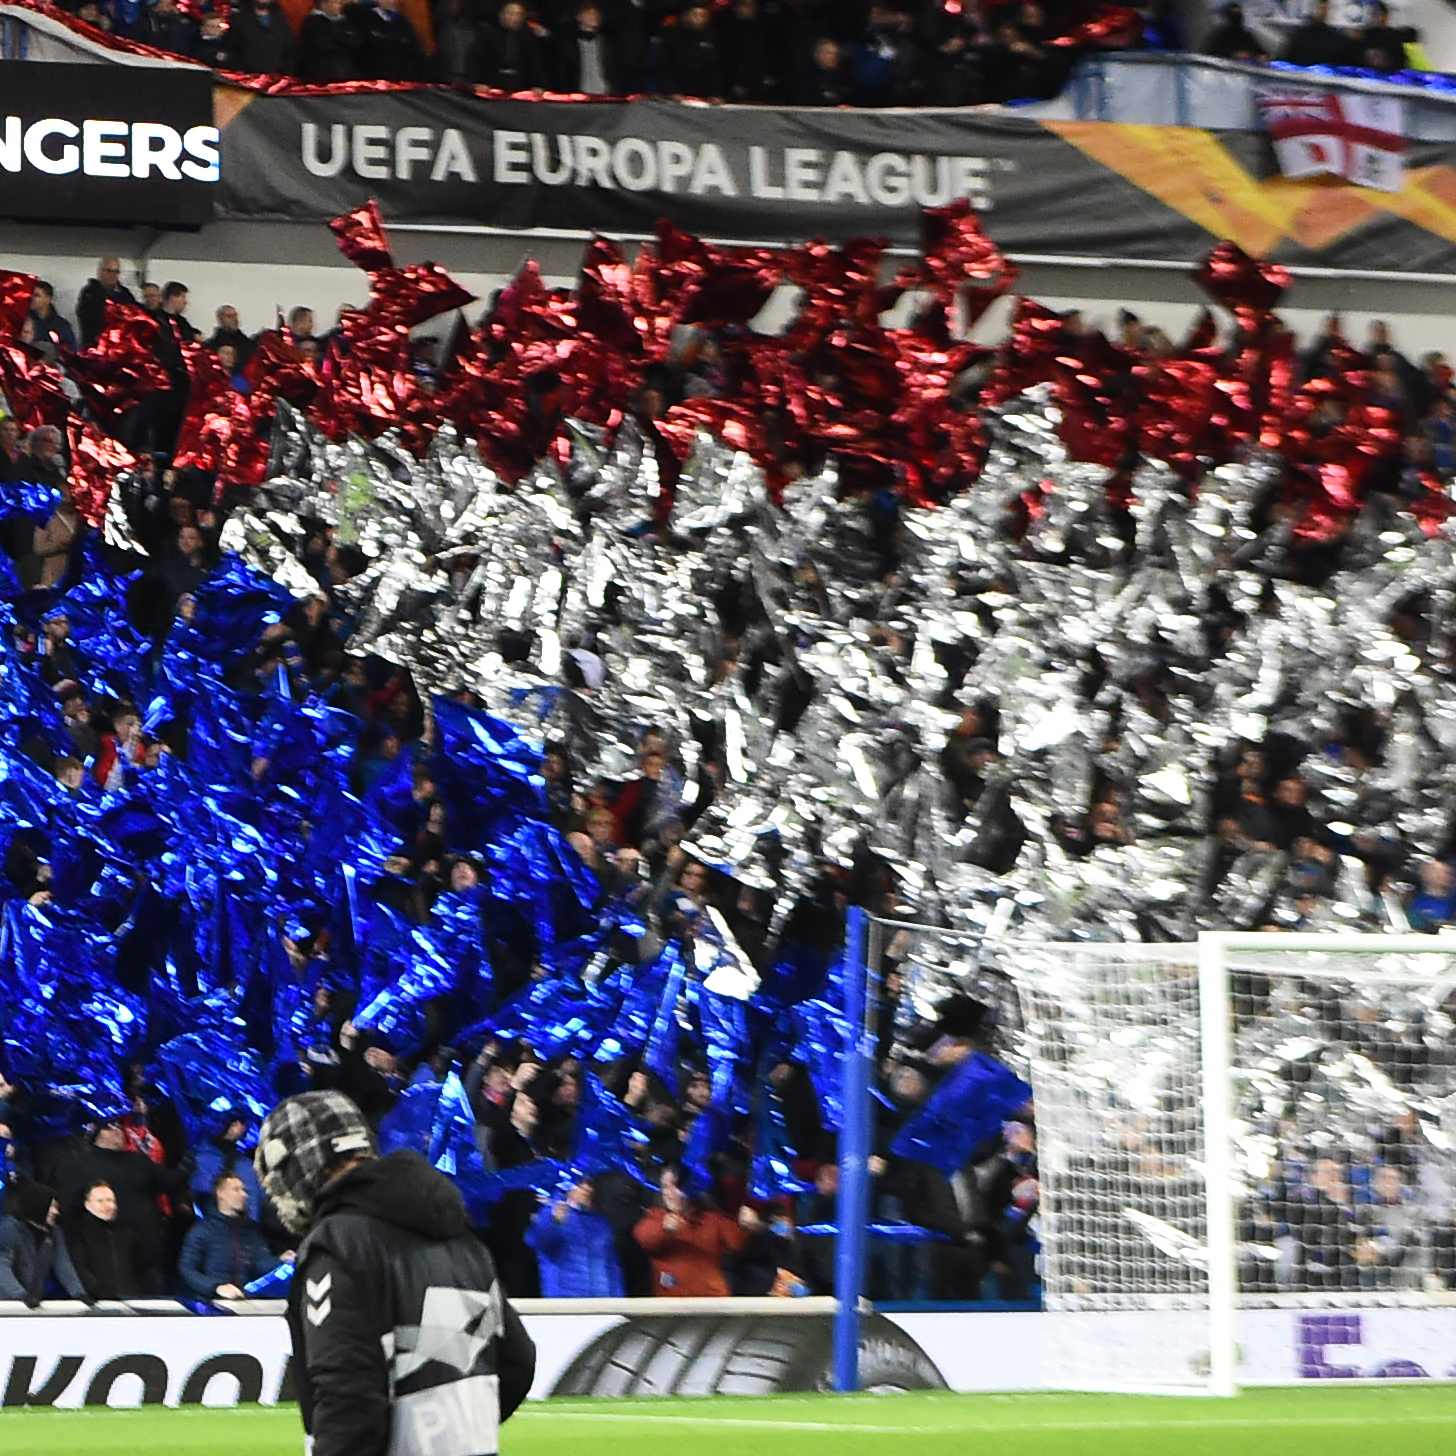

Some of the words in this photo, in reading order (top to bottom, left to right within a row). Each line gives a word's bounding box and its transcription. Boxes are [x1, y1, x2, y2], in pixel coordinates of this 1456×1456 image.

[301, 122, 477, 183] UEFA
[492, 129, 740, 196] EUROPA
[749, 145, 994, 209] LEAGUE
